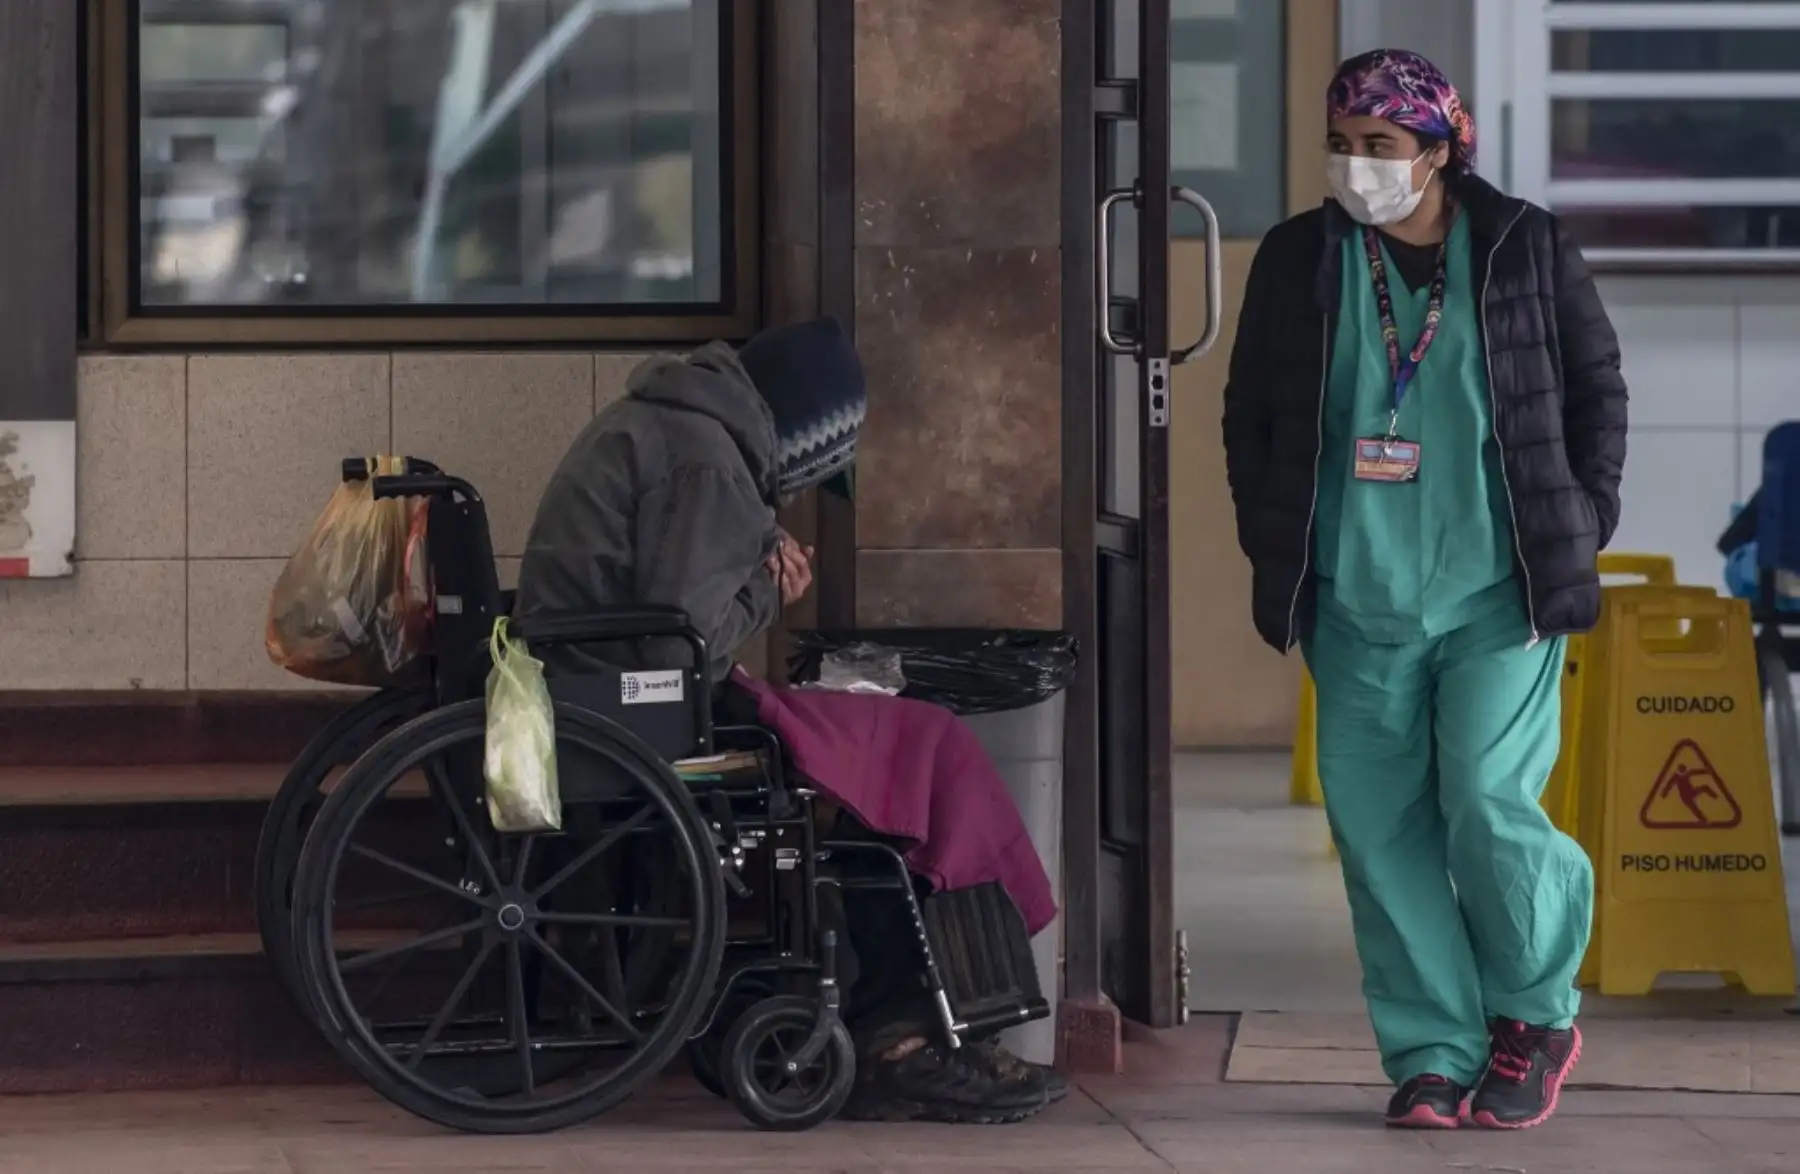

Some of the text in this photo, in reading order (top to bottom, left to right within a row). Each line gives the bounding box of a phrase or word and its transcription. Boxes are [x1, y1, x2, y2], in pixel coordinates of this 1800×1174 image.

[1636, 696, 1734, 713] CUIDADO
[1621, 855, 1766, 871] PISO HUMEDO
